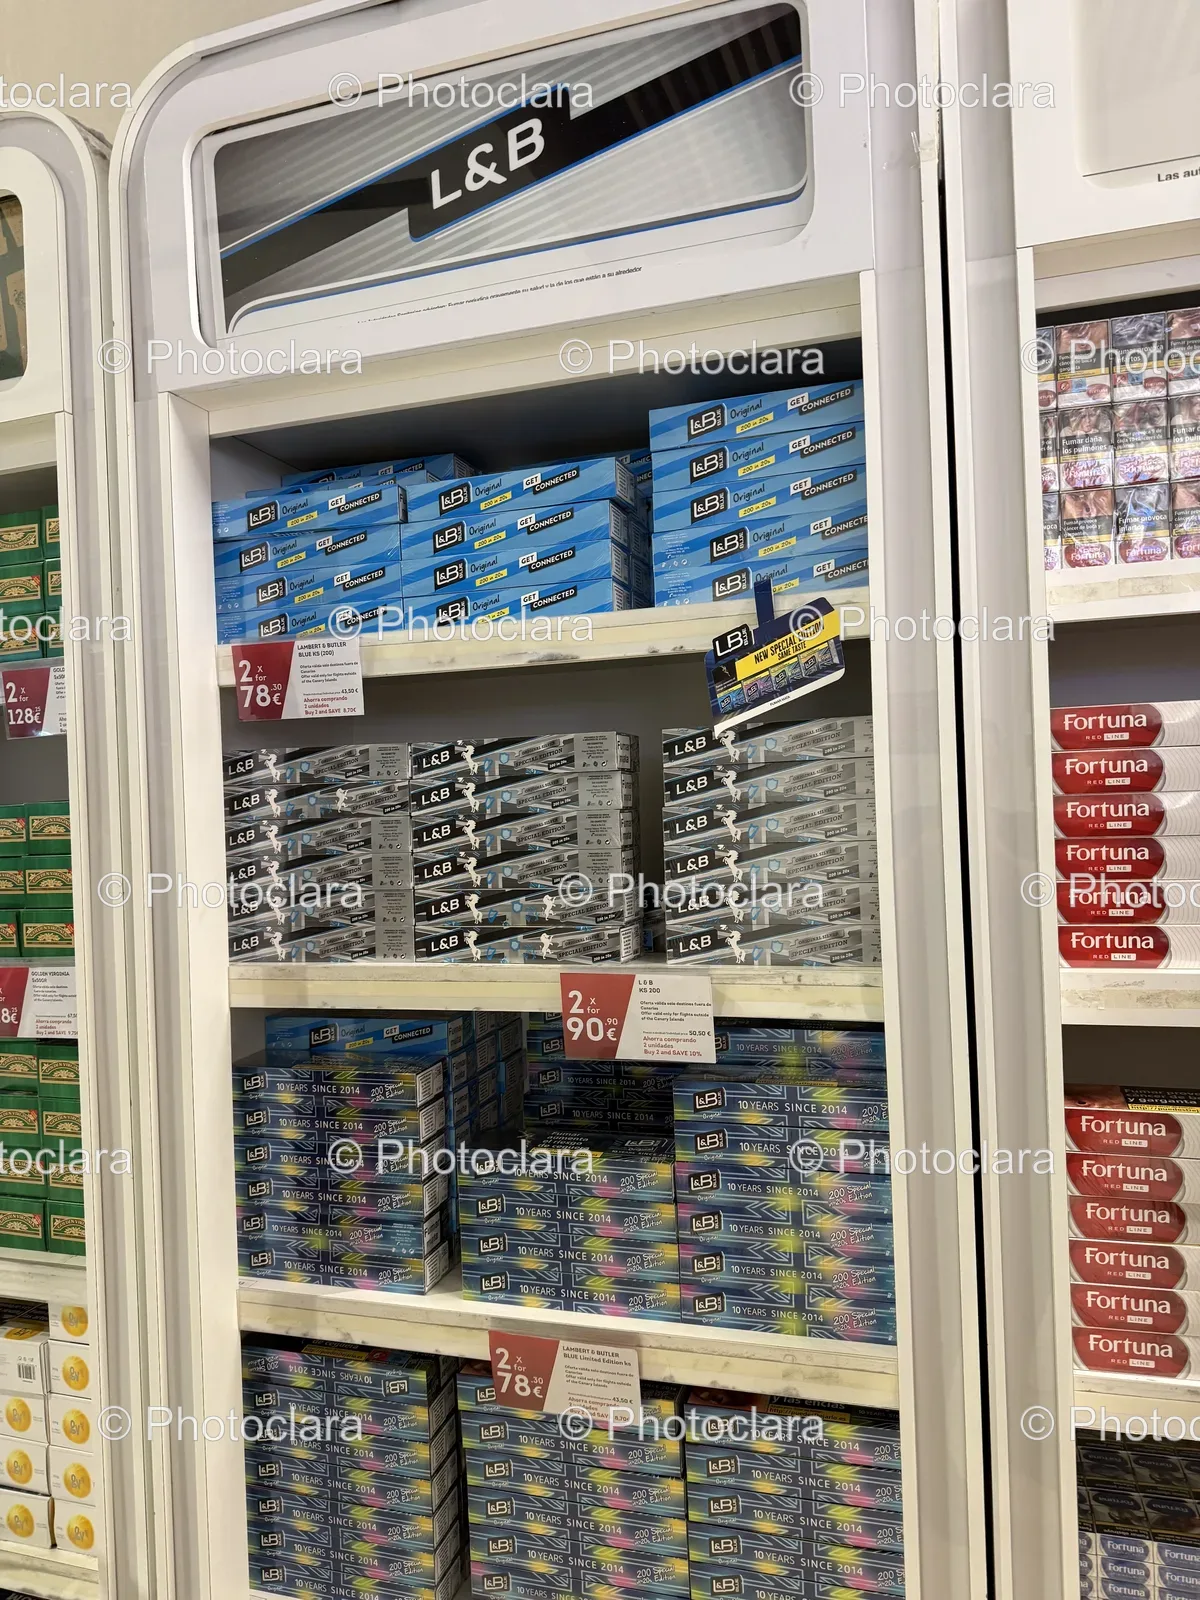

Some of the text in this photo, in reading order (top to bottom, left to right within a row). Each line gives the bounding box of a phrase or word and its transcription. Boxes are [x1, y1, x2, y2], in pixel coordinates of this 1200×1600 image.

[430, 117, 546, 210] L&B
[1157, 171, 1179, 183] Las
[615, 266, 642, 276] alrededor
[730, 399, 762, 419] Original
[790, 396, 806, 406] GET
[801, 388, 851, 412] CONNECTED
[690, 411, 717, 435] L&B
[1062, 446, 1072, 455] los
[474, 478, 502, 497] Original
[525, 475, 539, 486] GET
[535, 469, 577, 492] CONNECTED
[804, 472, 854, 497] CONNECTED
[339, 492, 380, 513] CONNECTED
[441, 488, 463, 511] L&B
[297, 643, 321, 651] LAMBERT
[320, 650, 335, 658] (200)
[754, 636, 797, 664] NEW SPECIAL
[777, 642, 807, 661] SAME TASTE
[239, 660, 253, 682] 2
[255, 674, 267, 682] for
[6, 681, 18, 703] 2
[240, 684, 271, 708] 78
[272, 693, 282, 705] €
[8, 708, 34, 725] 128
[34, 712, 42, 724] €
[1064, 713, 1147, 731] Fortuna
[674, 736, 707, 756] L&B
[813, 731, 841, 747] EDITION
[228, 758, 254, 776] L&B
[422, 750, 450, 768] L&B
[679, 935, 712, 954] L&B
[1070, 931, 1154, 950] Fortuna
[568, 990, 584, 1014] 2
[587, 1006, 600, 1014] for
[394, 1027, 431, 1042] CONNECTED
[566, 1016, 604, 1042] 90
[606, 1028, 618, 1042] €
[695, 1092, 719, 1111] L&B
[737, 1100, 848, 1115] 10 YEARS SINCE 2014
[1080, 1115, 1167, 1137] Fortuna
[828, 1188, 845, 1201] 200
[562, 1346, 590, 1354] LAMBERT
[596, 1349, 620, 1358] BUTLER
[1088, 1334, 1173, 1358] Fortuna
[495, 1347, 511, 1370] 2
[579, 1355, 601, 1363] Limited
[602, 1358, 623, 1366] Edition
[513, 1363, 527, 1373] for
[496, 1371, 531, 1397] 78
[532, 1386, 544, 1398] €
[293, 1509, 377, 1531] 10 YEARS SINCE 2014
[1107, 1541, 1144, 1554] Fortuna
